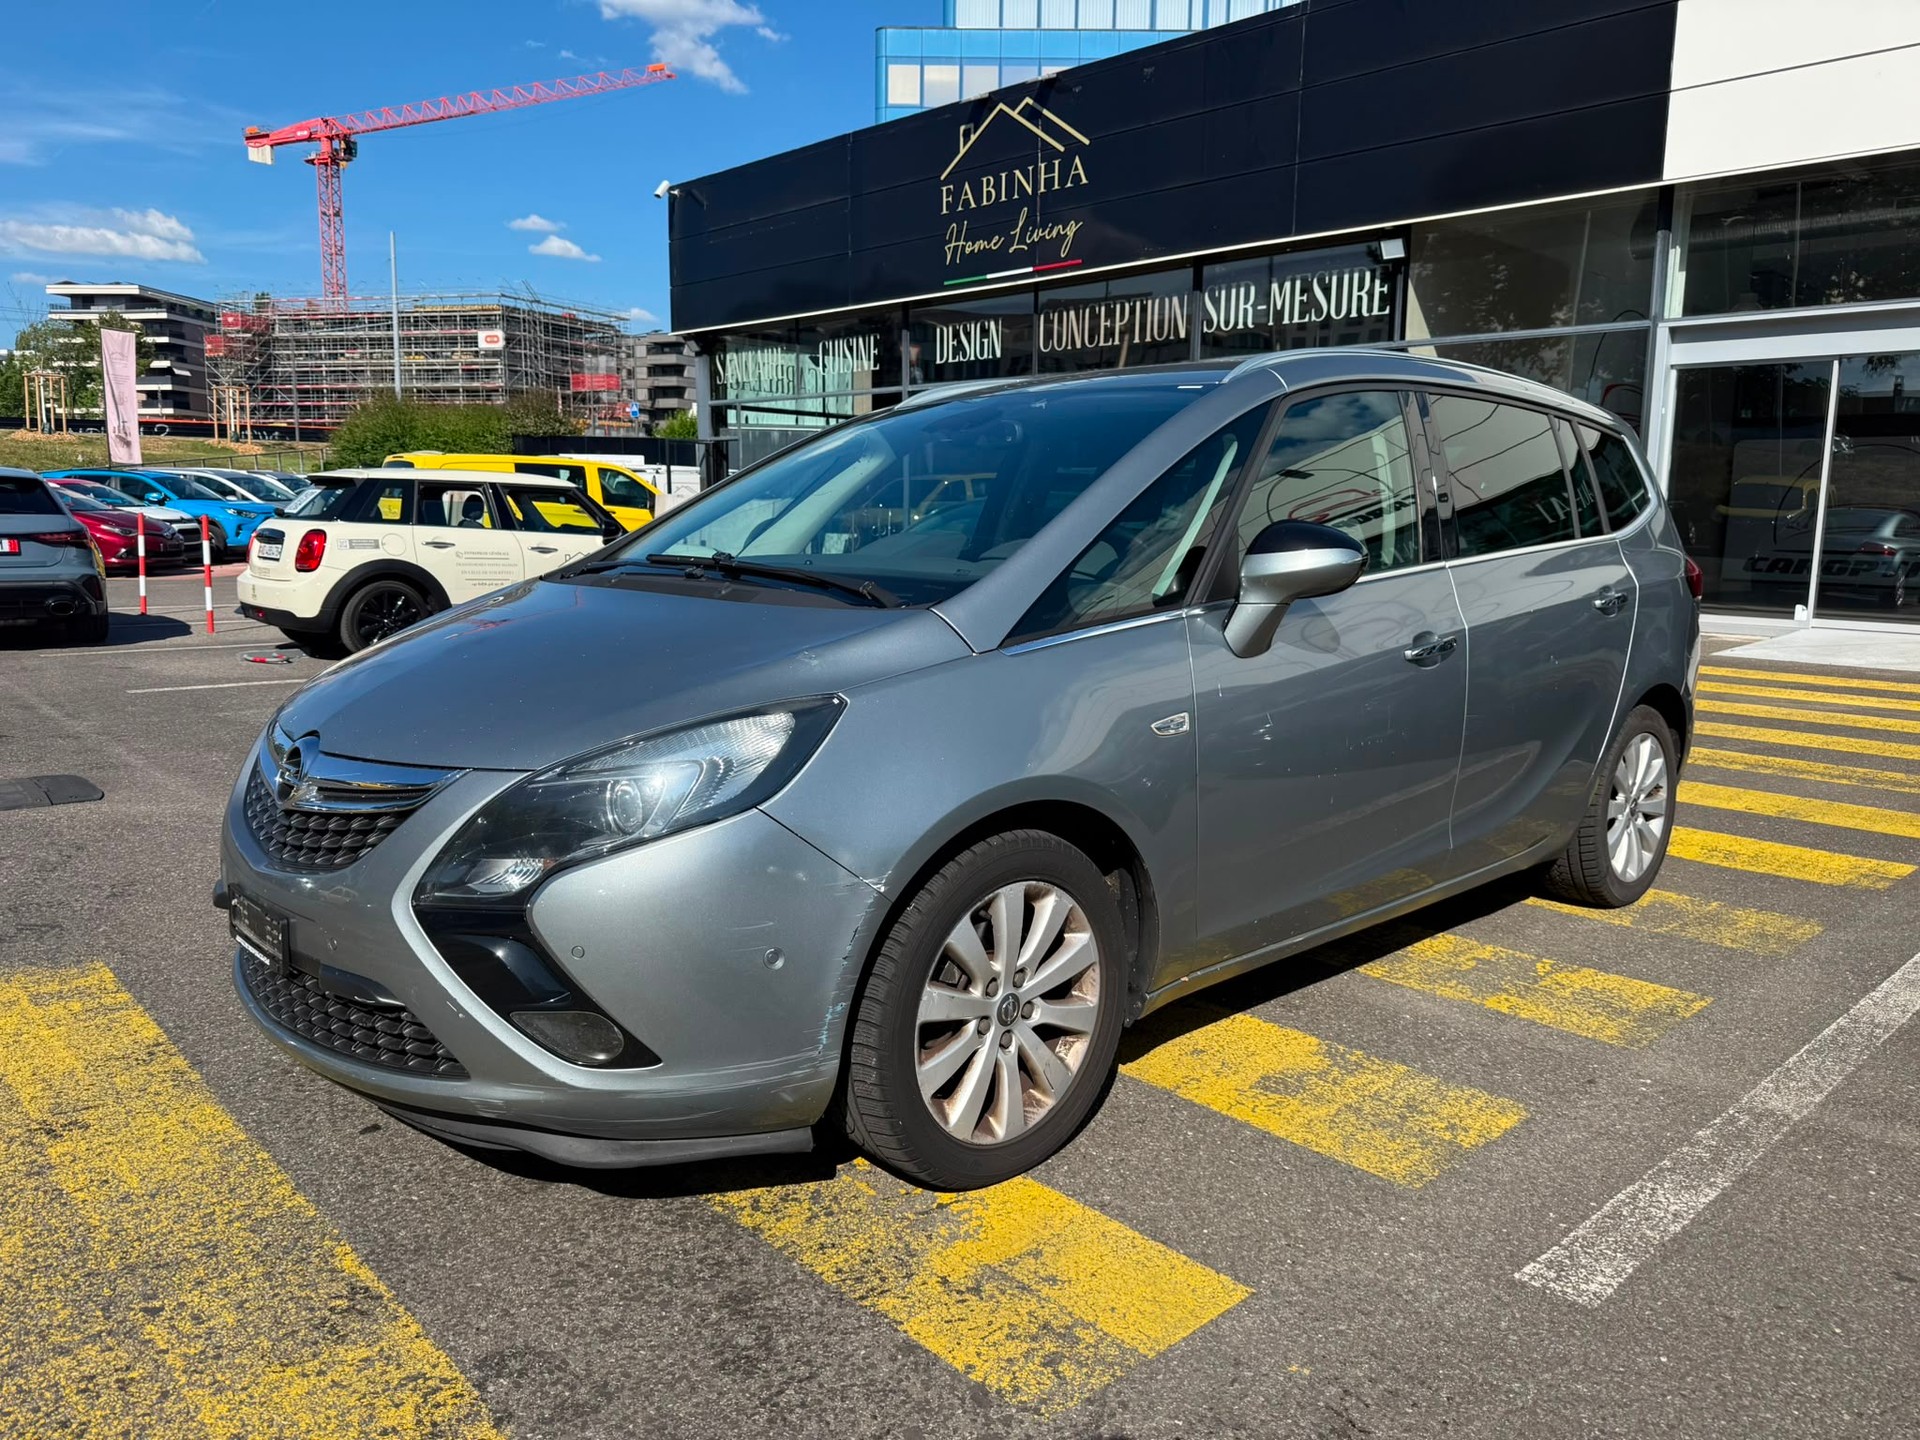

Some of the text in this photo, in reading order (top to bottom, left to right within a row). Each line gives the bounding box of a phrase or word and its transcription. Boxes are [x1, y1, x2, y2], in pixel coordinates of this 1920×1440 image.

[939, 154, 1089, 216] FABINHA
[944, 206, 1084, 266] Home Living
[818, 332, 881, 376] CUISINE
[935, 317, 1002, 365] DESIGN
[1038, 293, 1189, 353] CONCEPTION
[1202, 264, 1393, 334] SUR-MESURE
